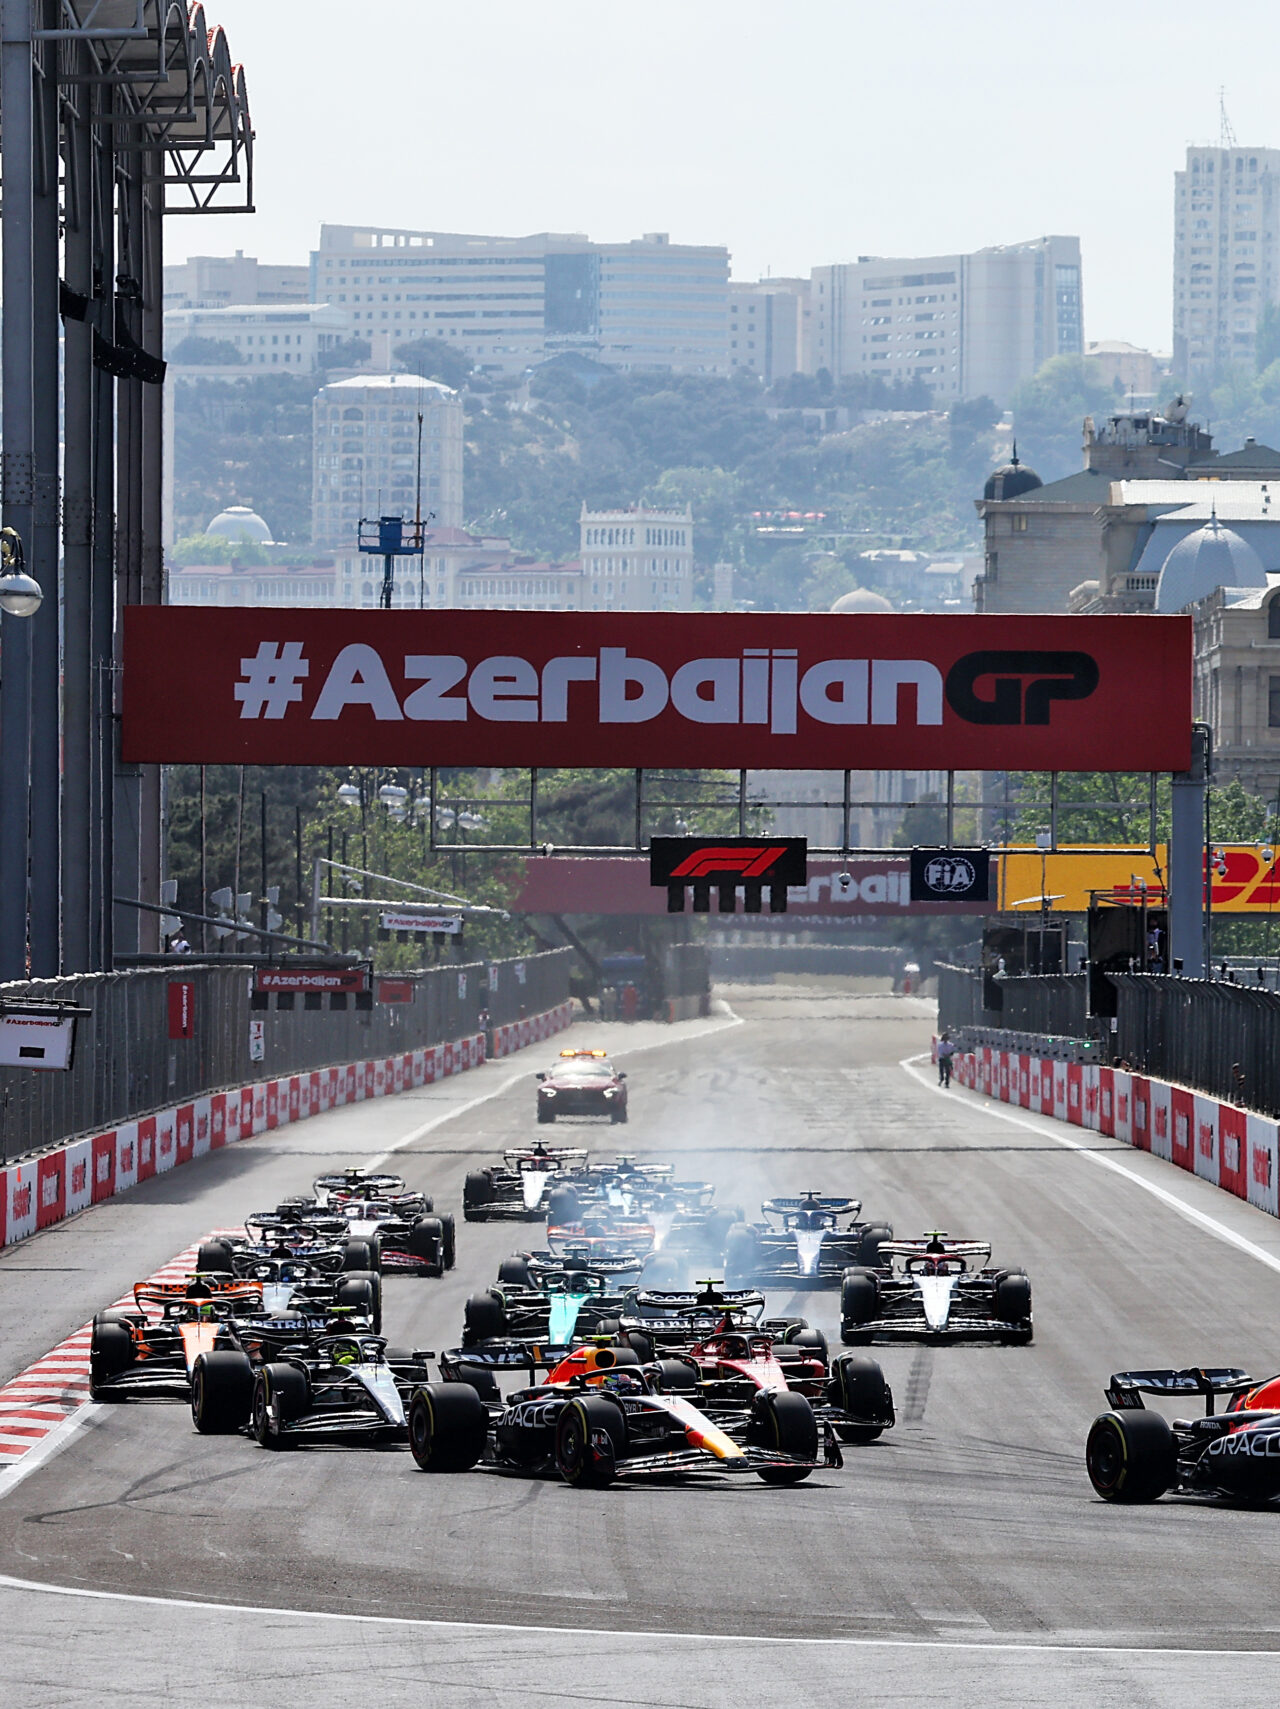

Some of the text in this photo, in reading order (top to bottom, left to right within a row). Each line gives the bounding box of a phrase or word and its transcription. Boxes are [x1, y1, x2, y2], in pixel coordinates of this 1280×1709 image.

[251, 1320, 329, 1330] PETRON
[497, 1405, 557, 1428] ORACLE
[1200, 1421, 1222, 1430] HONDA
